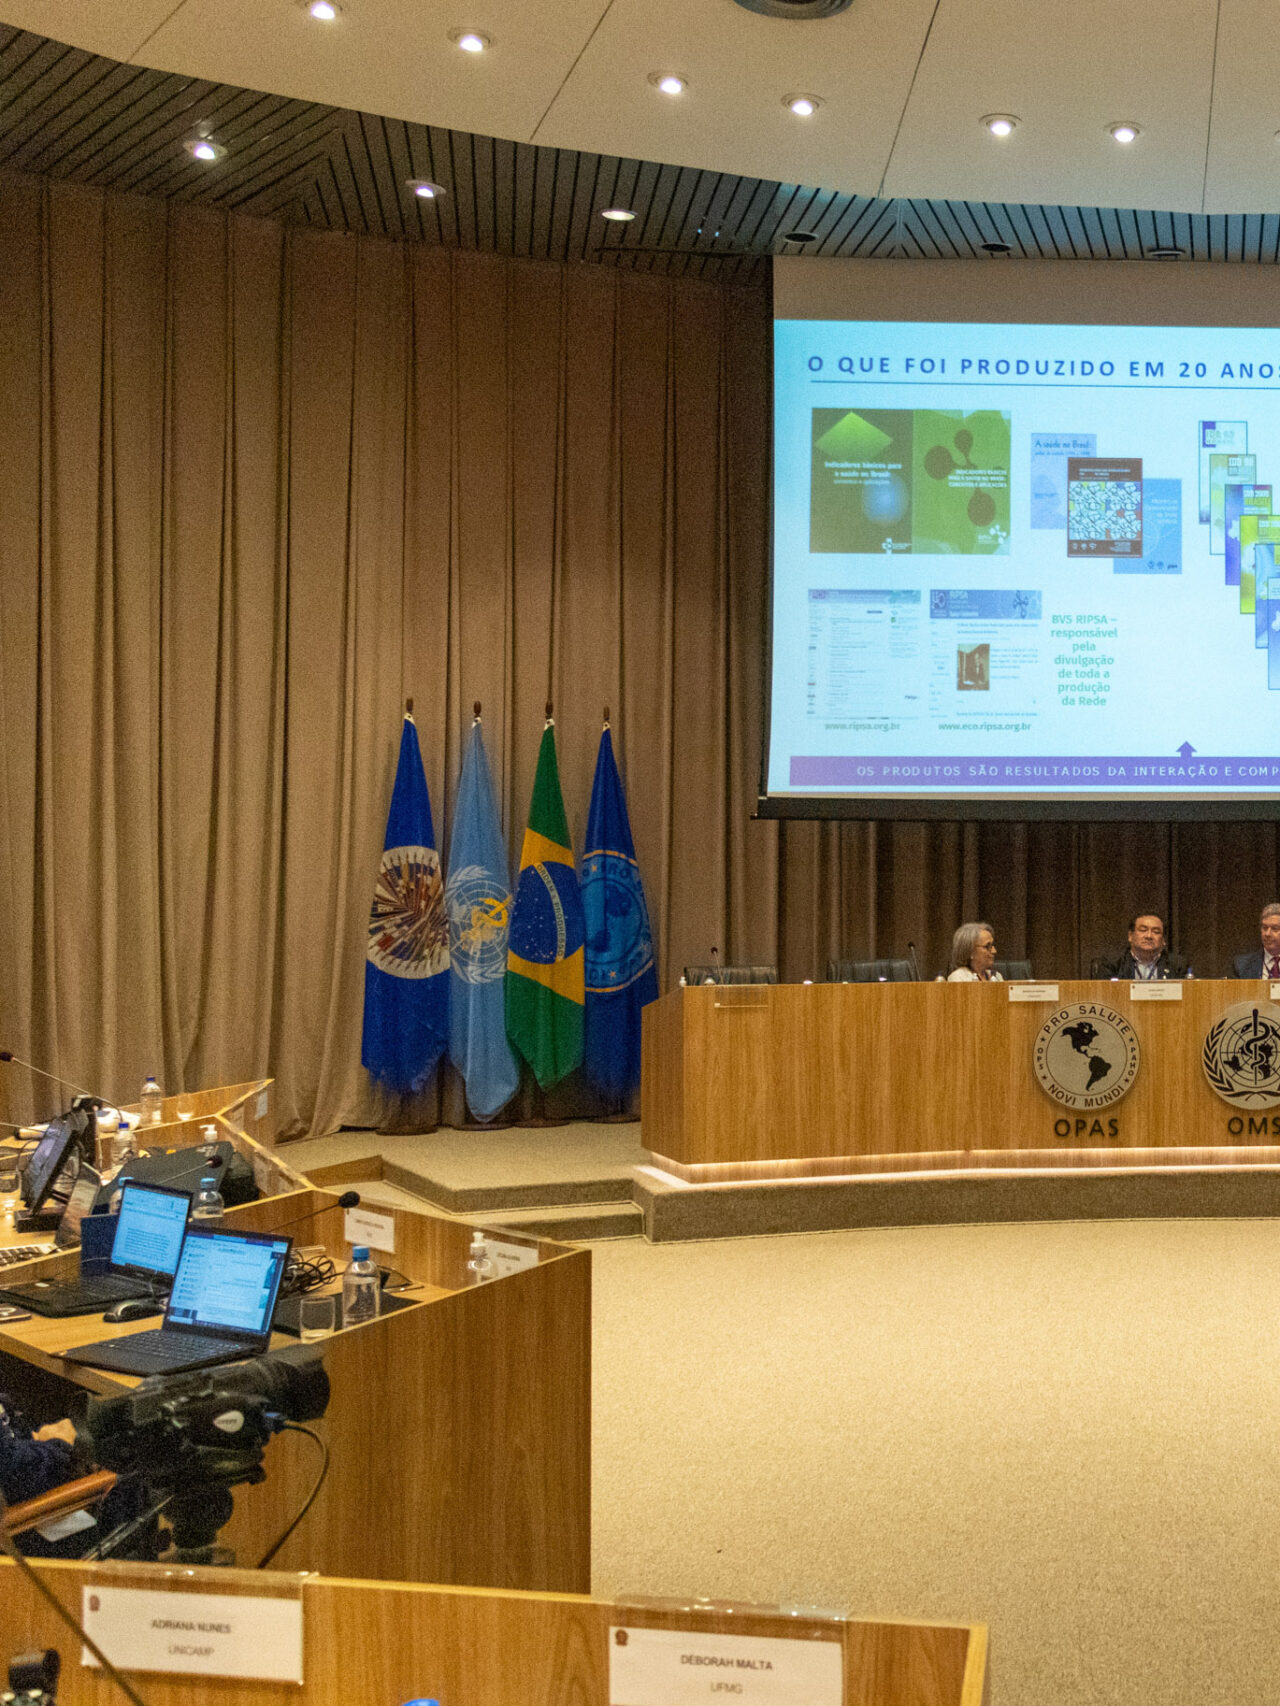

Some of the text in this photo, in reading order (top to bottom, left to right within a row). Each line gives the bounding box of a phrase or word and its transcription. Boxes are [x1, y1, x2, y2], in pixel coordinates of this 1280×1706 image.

[808, 356, 824, 372] O
[838, 357, 890, 375] QUE
[905, 358, 946, 373] FOI
[960, 359, 1115, 376] PRODUZIDO
[1129, 361, 1165, 377] EM
[1178, 362, 1208, 378] 20
[1052, 615, 1072, 624] BVS
[1076, 615, 1108, 624] RIPSA
[1050, 628, 1118, 639] responsável
[1072, 641, 1096, 653] pela
[1054, 655, 1115, 667] divulgação
[1058, 669, 1110, 678] de toda a
[1058, 682, 1111, 694] produção
[1062, 696, 1106, 705] da Rede
[824, 721, 901, 732] www.ripsa.org.br
[938, 722, 1032, 733] www.eco.ripsa.org.br
[857, 766, 875, 776] OS
[882, 766, 961, 776] PRODUTOS
[969, 764, 999, 776] SÃO
[1005, 766, 1101, 777] RESULTADOS
[1108, 766, 1127, 776] DA
[1134, 765, 1219, 778] INTERAÇÃO
[1225, 767, 1232, 776] E
[1043, 1005, 1131, 1035] PRO SALUTE
[1127, 1046, 1137, 1076] PAHO
[1047, 1083, 1125, 1107] NOVI MUNDI
[1054, 1118, 1119, 1137] OPAS
[151, 1618, 195, 1634] ADRIANA
[680, 1654, 773, 1671] DÉBORAH MALTA
[710, 1681, 743, 1694] UFMG
